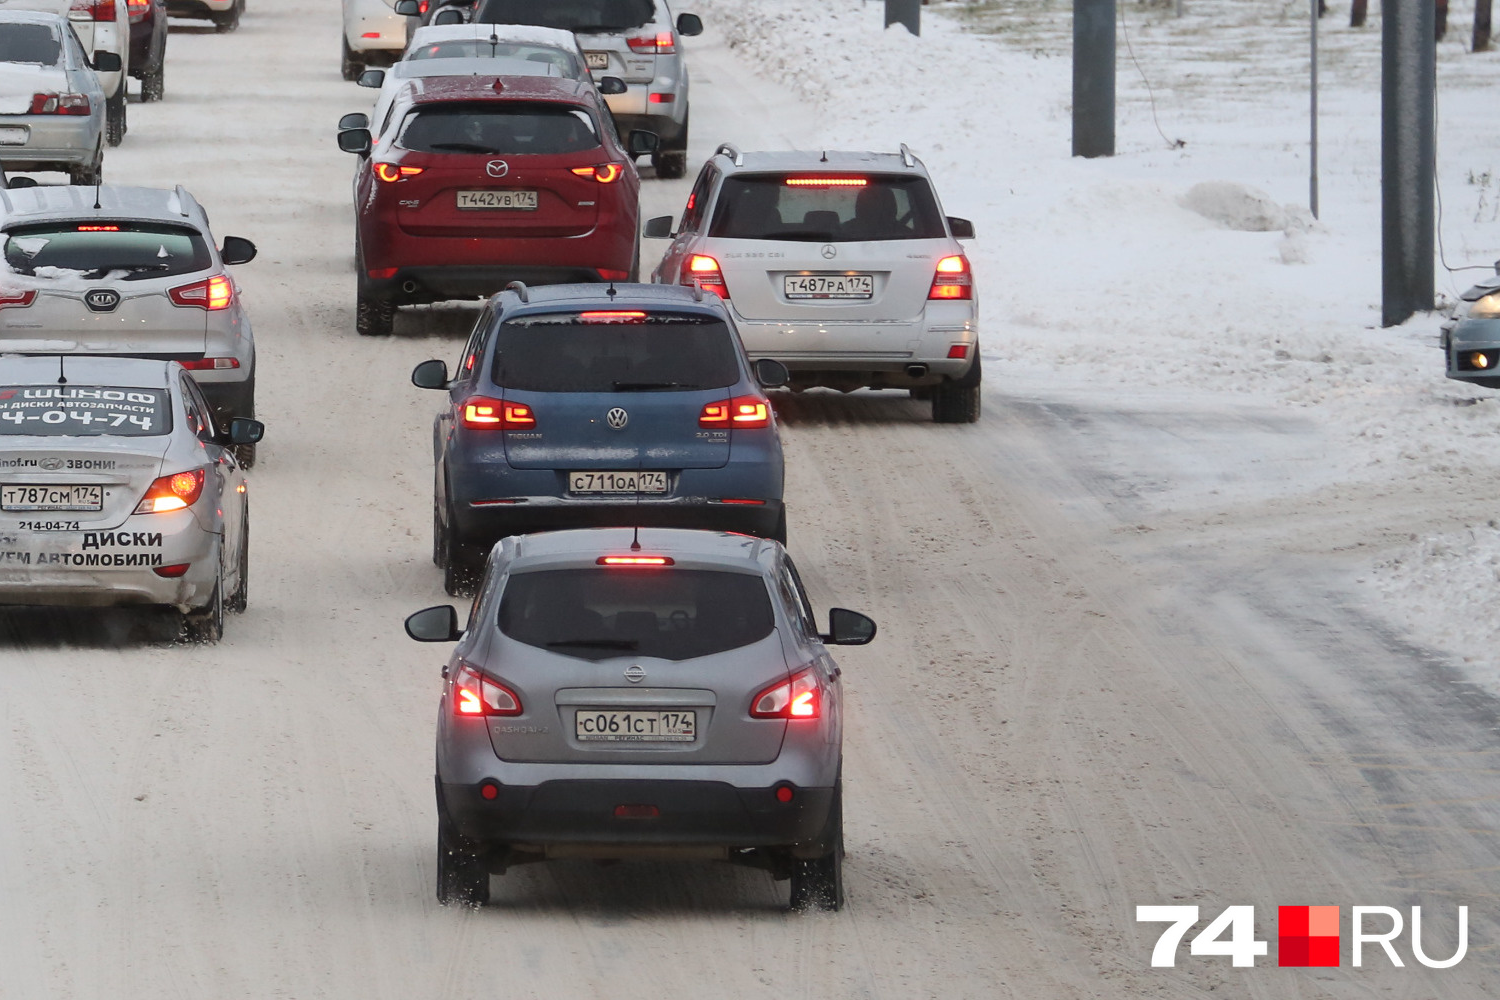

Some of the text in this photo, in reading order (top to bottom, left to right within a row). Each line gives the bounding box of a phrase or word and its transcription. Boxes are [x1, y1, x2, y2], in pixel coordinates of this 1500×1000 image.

[461, 192, 534, 206] Т442УВ 174
[790, 278, 870, 292] Т487РА 174
[93, 295, 112, 303] KIA
[11, 401, 53, 409] ДИСКИ
[56, 401, 155, 413] АВТОЗАПЧАСТИ
[575, 473, 663, 490] С711ОА 174
[7, 487, 98, 503] Т787СМ 174
[18, 521, 80, 530] 214-04-74
[82, 532, 163, 550] ДИСКИ
[36, 553, 163, 566] АВТОМОБИЛИ
[583, 713, 690, 733] С061СТ 174
